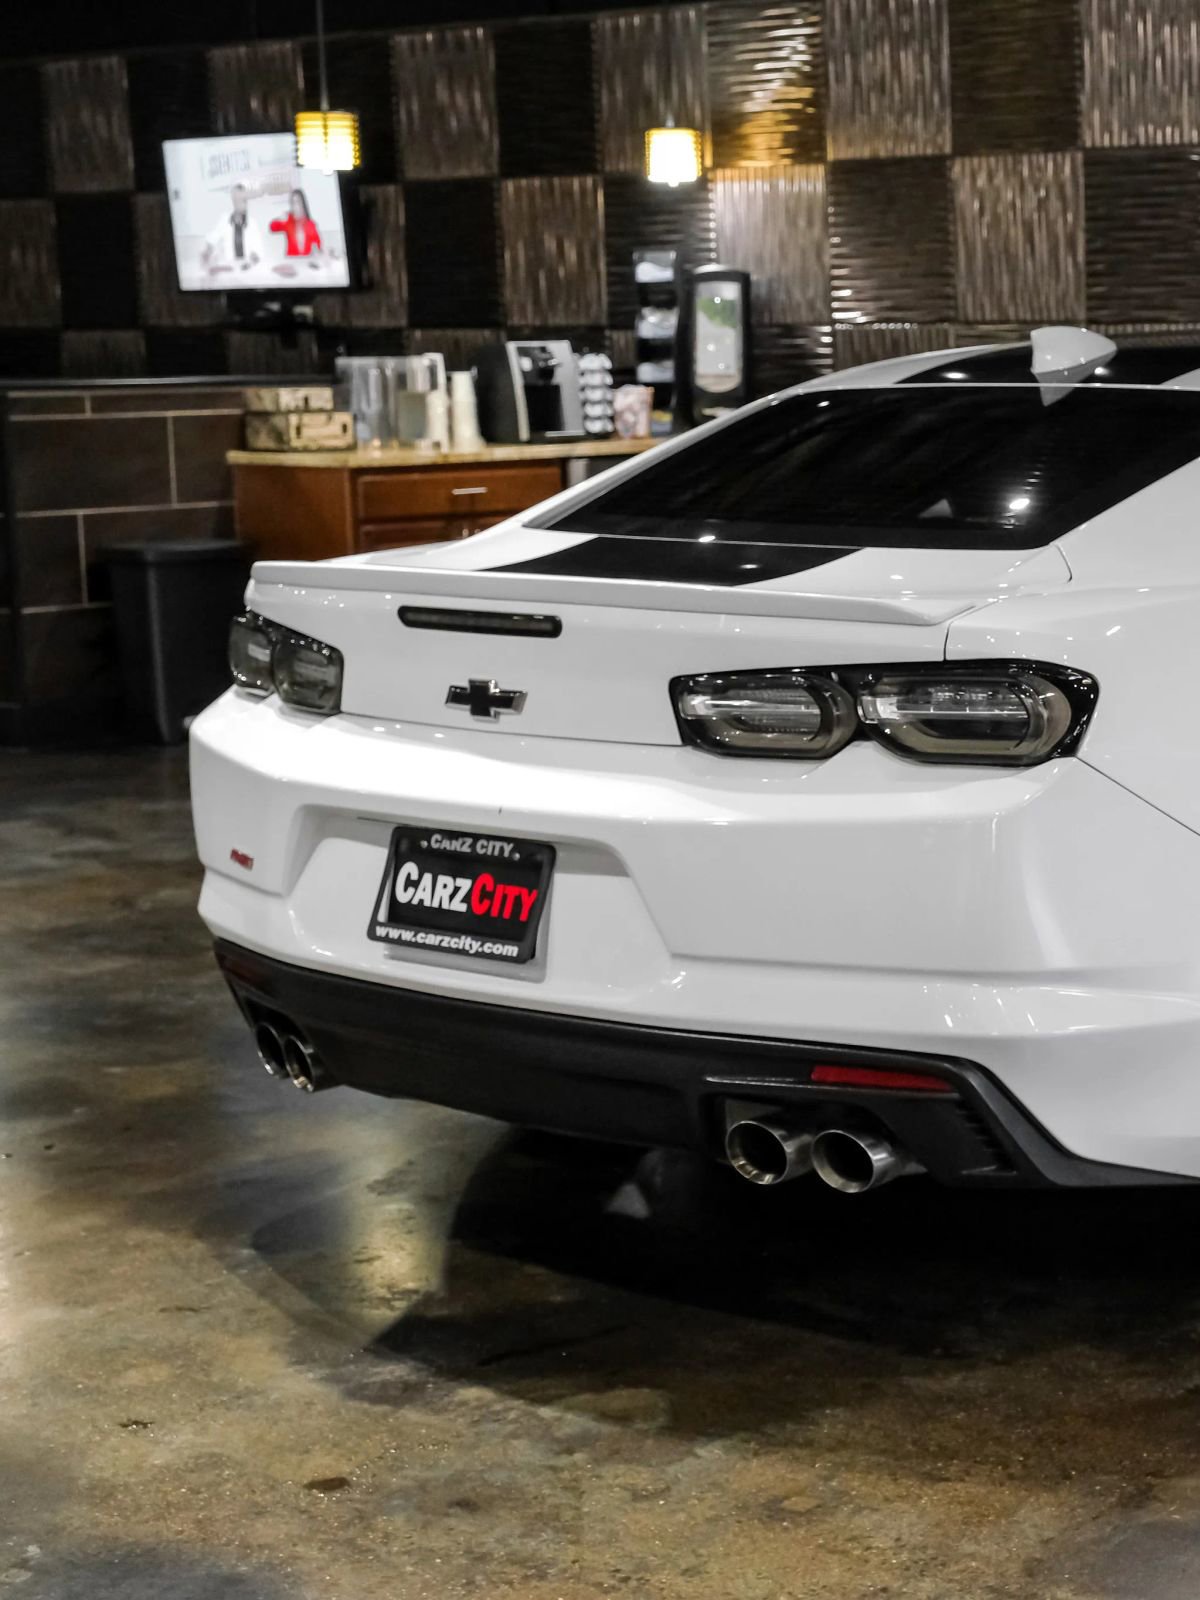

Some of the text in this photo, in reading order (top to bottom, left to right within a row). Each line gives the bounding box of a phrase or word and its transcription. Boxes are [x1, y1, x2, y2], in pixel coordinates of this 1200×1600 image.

[430, 833, 514, 858] CARZ CITY
[375, 925, 519, 958] www.carzcity.com
